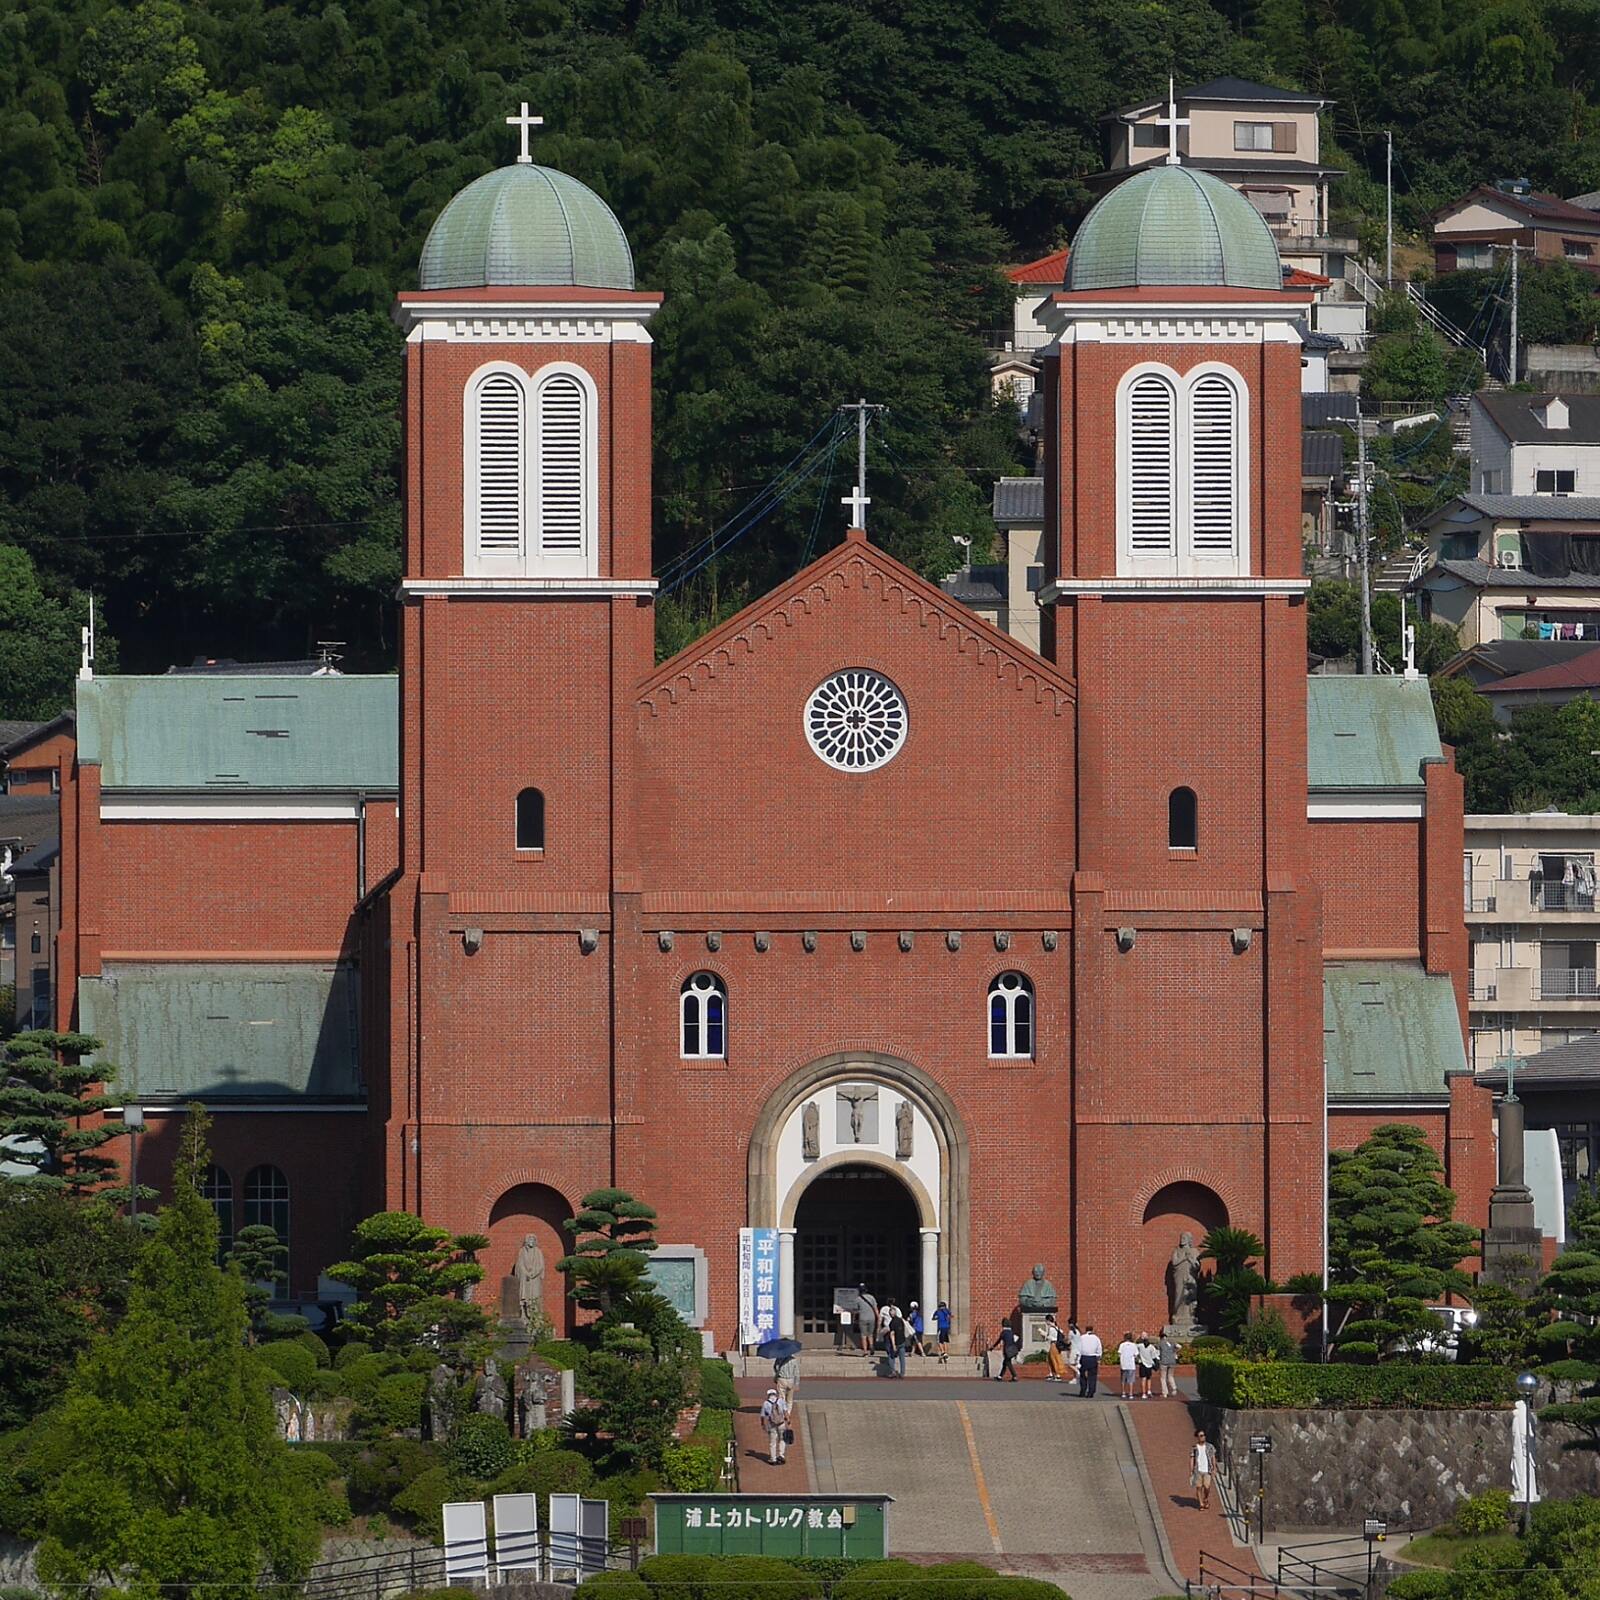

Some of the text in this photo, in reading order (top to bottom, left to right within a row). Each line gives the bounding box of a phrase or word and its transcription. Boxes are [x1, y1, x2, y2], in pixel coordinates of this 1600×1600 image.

[757, 1239, 774, 1330] 平和祈願祭
[685, 1507, 842, 1528] 浦上カトリック教会
